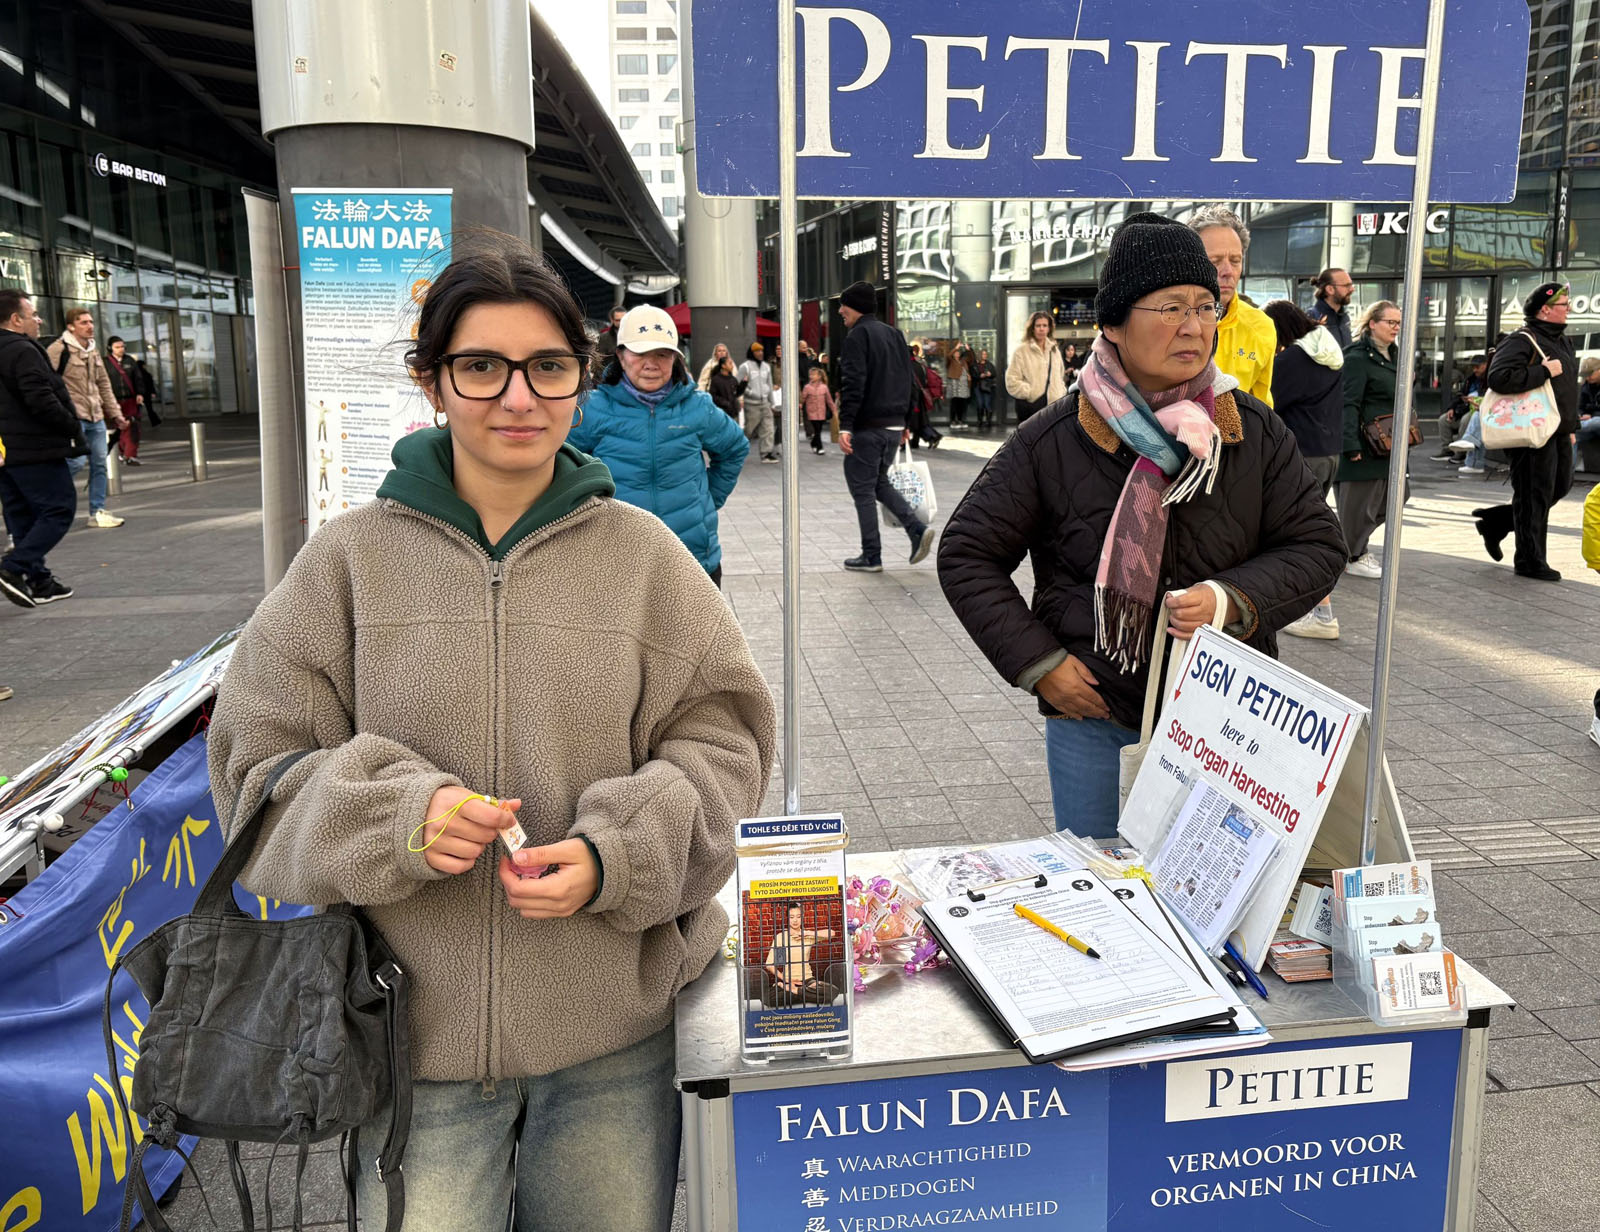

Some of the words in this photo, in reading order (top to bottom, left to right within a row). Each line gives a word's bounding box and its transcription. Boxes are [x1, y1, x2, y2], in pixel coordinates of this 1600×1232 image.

[796, 6, 1427, 165] PETITIE
[112, 161, 134, 178] BAR
[134, 167, 167, 187] BETON
[311, 198, 433, 222] 法輪大法
[1378, 210, 1449, 235] KC
[302, 226, 375, 249] FALUN
[382, 226, 445, 249] DAFA
[880, 211, 890, 281] MANNEKENPIS
[1190, 650, 1237, 698] SIGN
[1237, 675, 1337, 757] PETITION
[1219, 718, 1247, 746] here
[1247, 739, 1260, 756] to
[1158, 754, 1175, 775] from
[1167, 719, 1192, 753] Stop
[1194, 737, 1229, 779] Organ
[1228, 761, 1301, 834] Harvesting
[747, 826, 771, 834] TOHLE
[781, 824, 799, 832] DĚJE
[800, 823, 814, 831] TEĎ
[821, 822, 839, 830] ČÍNĚ
[769, 887, 791, 895] ZLOČINY
[1204, 1062, 1374, 1109] PETITIE
[775, 1098, 928, 1142] FALUN
[946, 1086, 1071, 1127] DAFA
[801, 1157, 830, 1180] 真
[836, 1142, 1032, 1174] WAARACHTIGHEID
[1166, 1140, 1323, 1174] VERMOORD
[1328, 1132, 1406, 1157] VOOR
[801, 1187, 830, 1208] 善
[838, 1176, 976, 1204] MEDEDOGEN
[1150, 1175, 1284, 1208] ORGANEN
[1293, 1171, 1324, 1192] IN
[1331, 1161, 1418, 1187] CHINA
[838, 1200, 1059, 1232] VERDRAAGZAAMHEID
